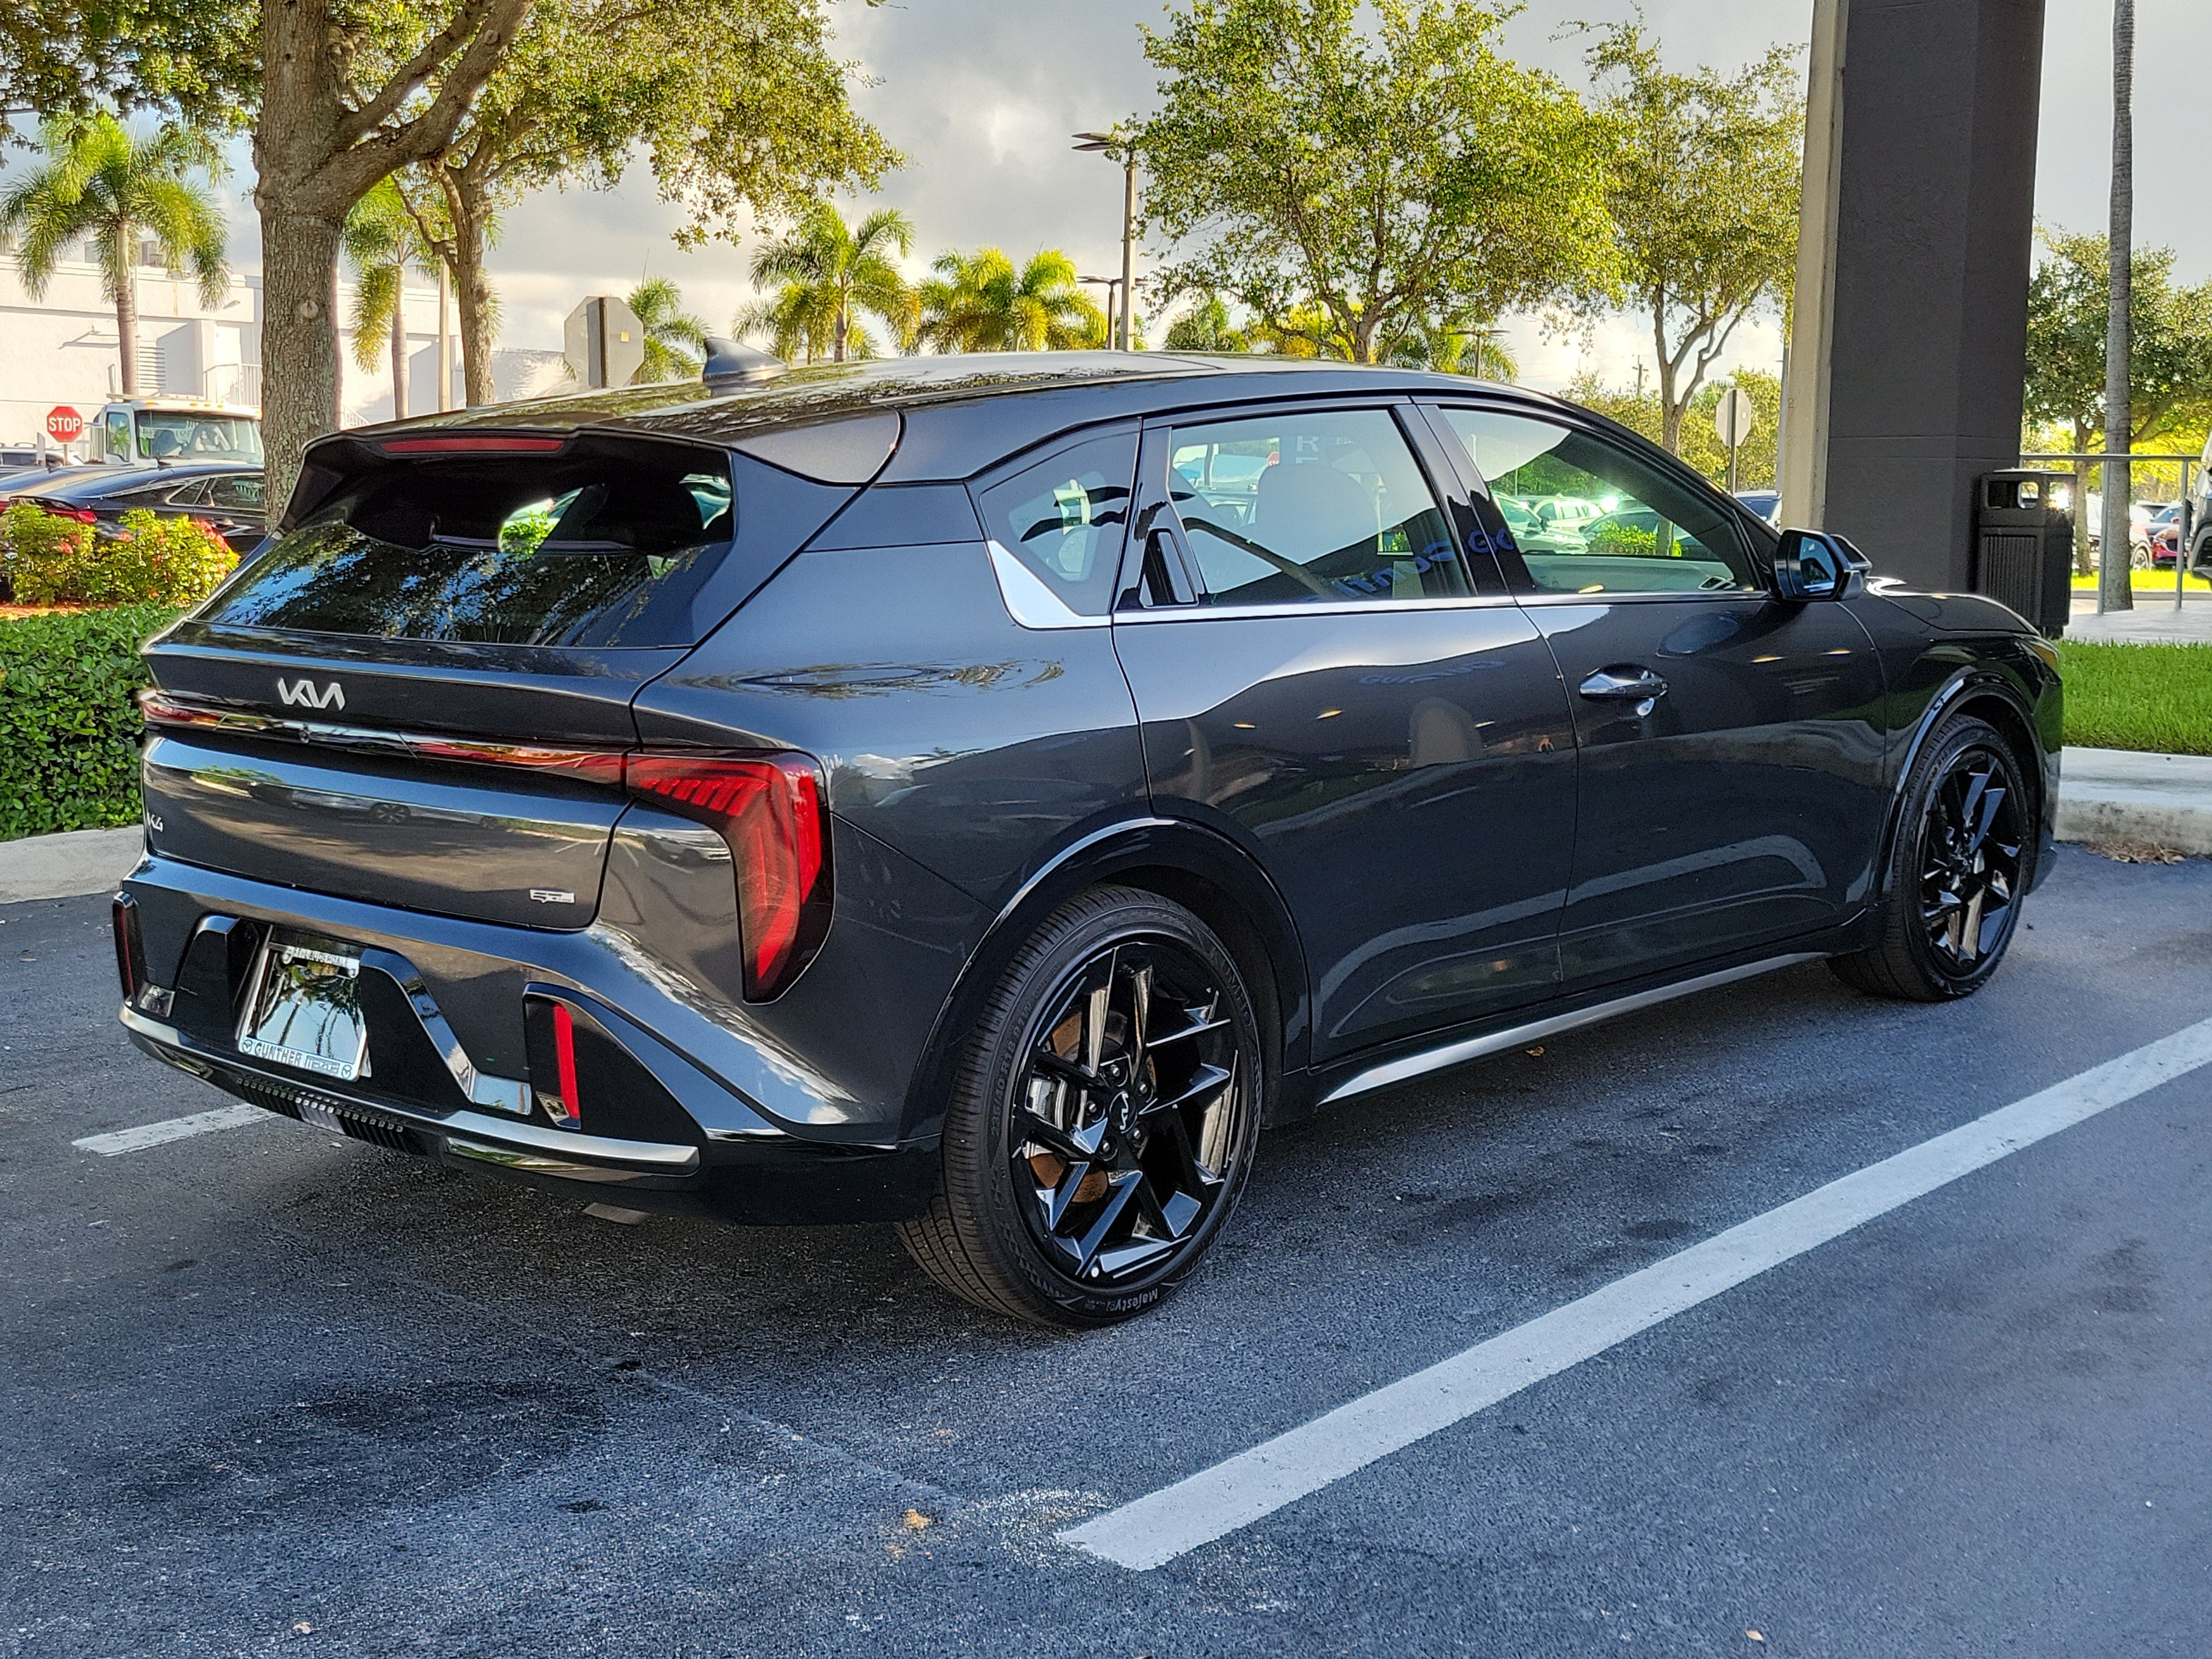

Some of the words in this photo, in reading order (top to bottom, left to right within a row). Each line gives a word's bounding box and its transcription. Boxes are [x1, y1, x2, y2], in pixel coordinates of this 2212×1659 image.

[49, 417, 81, 433] STOP
[278, 678, 346, 710] KIA
[255, 1042, 303, 1066] GUNTHER
